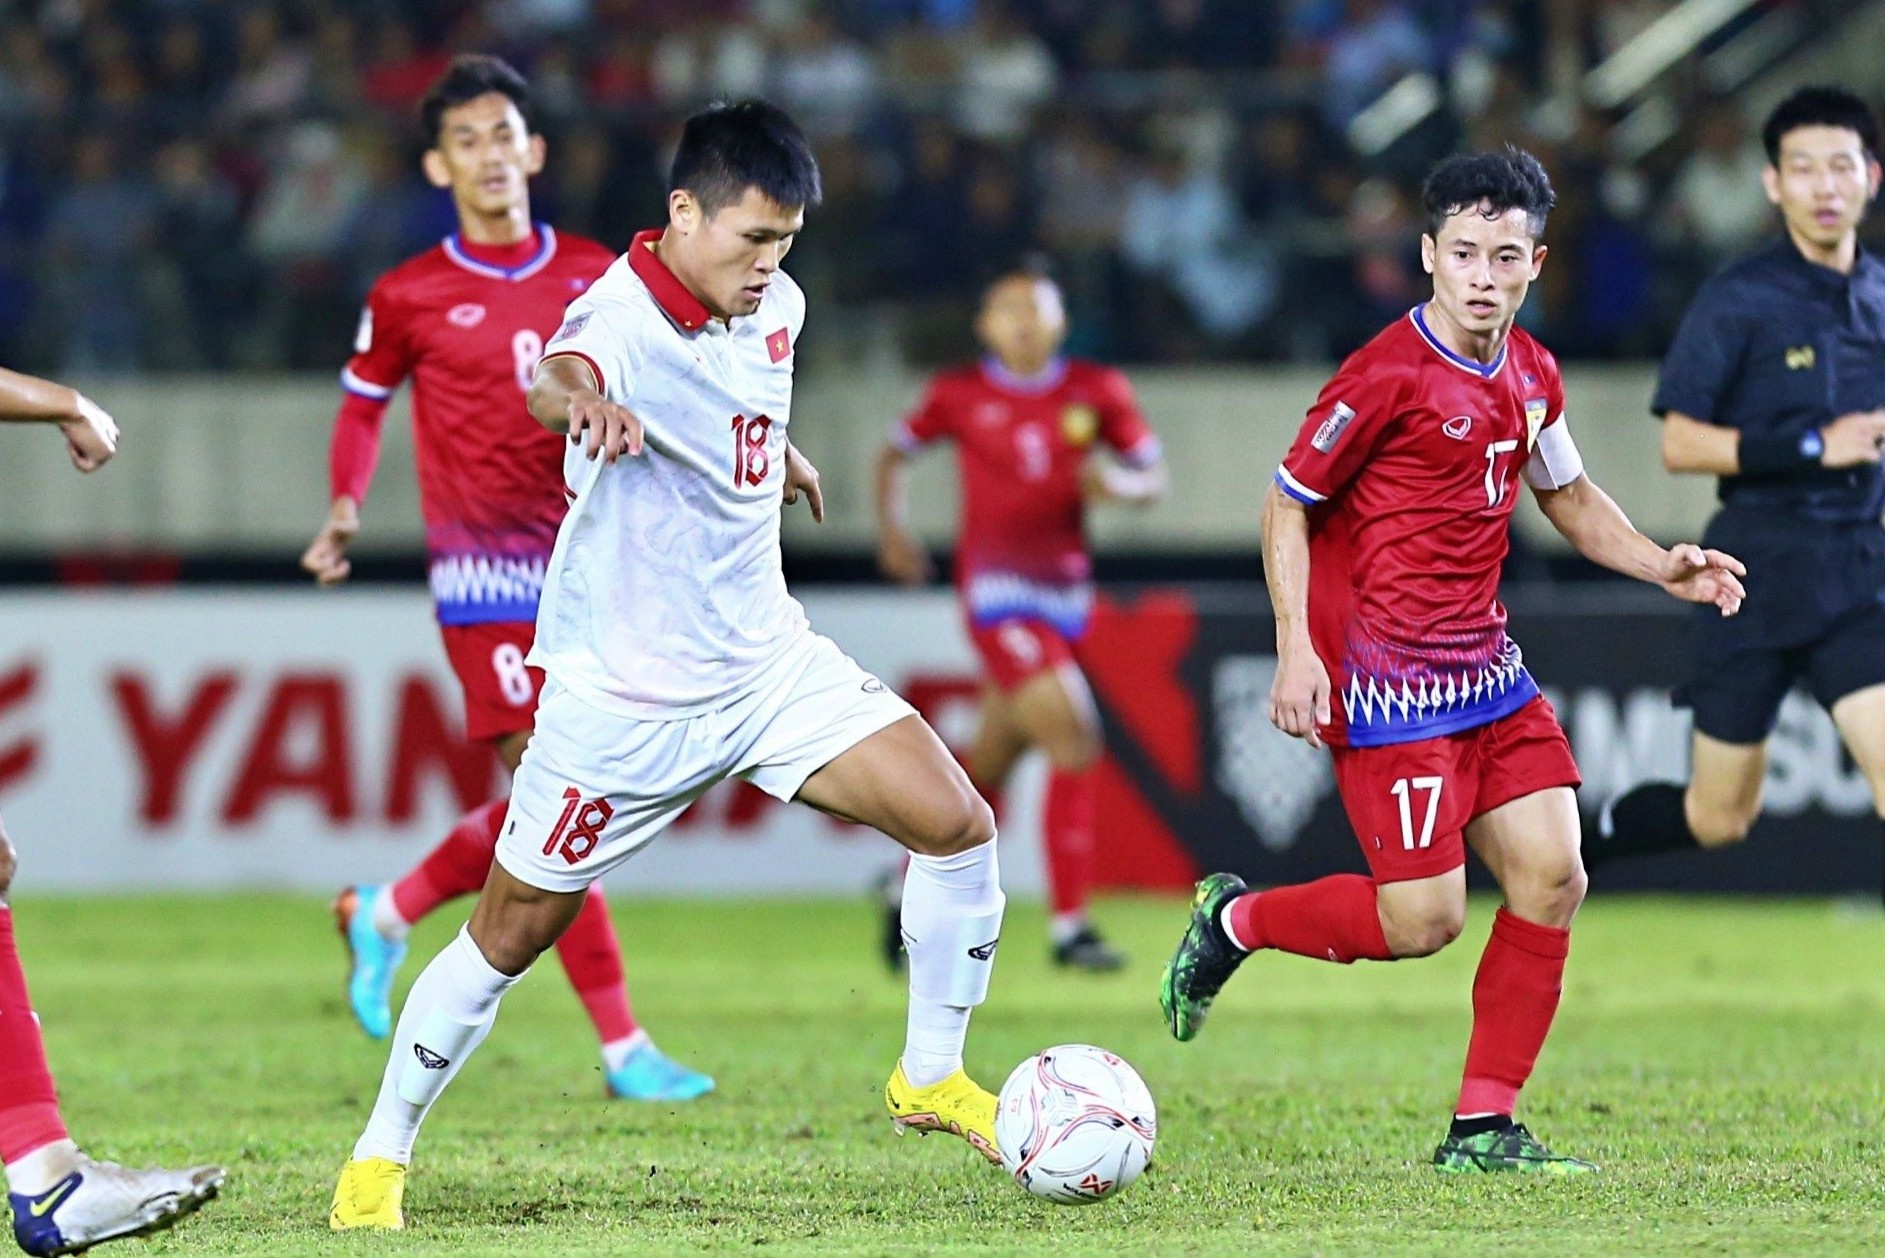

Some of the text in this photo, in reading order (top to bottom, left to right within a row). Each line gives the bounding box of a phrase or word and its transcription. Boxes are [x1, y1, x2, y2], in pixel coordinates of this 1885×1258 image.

[511, 328, 543, 393] 8
[731, 413, 772, 489] 18
[1485, 439, 1518, 508] 17
[491, 642, 533, 707] 8
[542, 786, 614, 865] 18
[1390, 776, 1443, 850] 17
